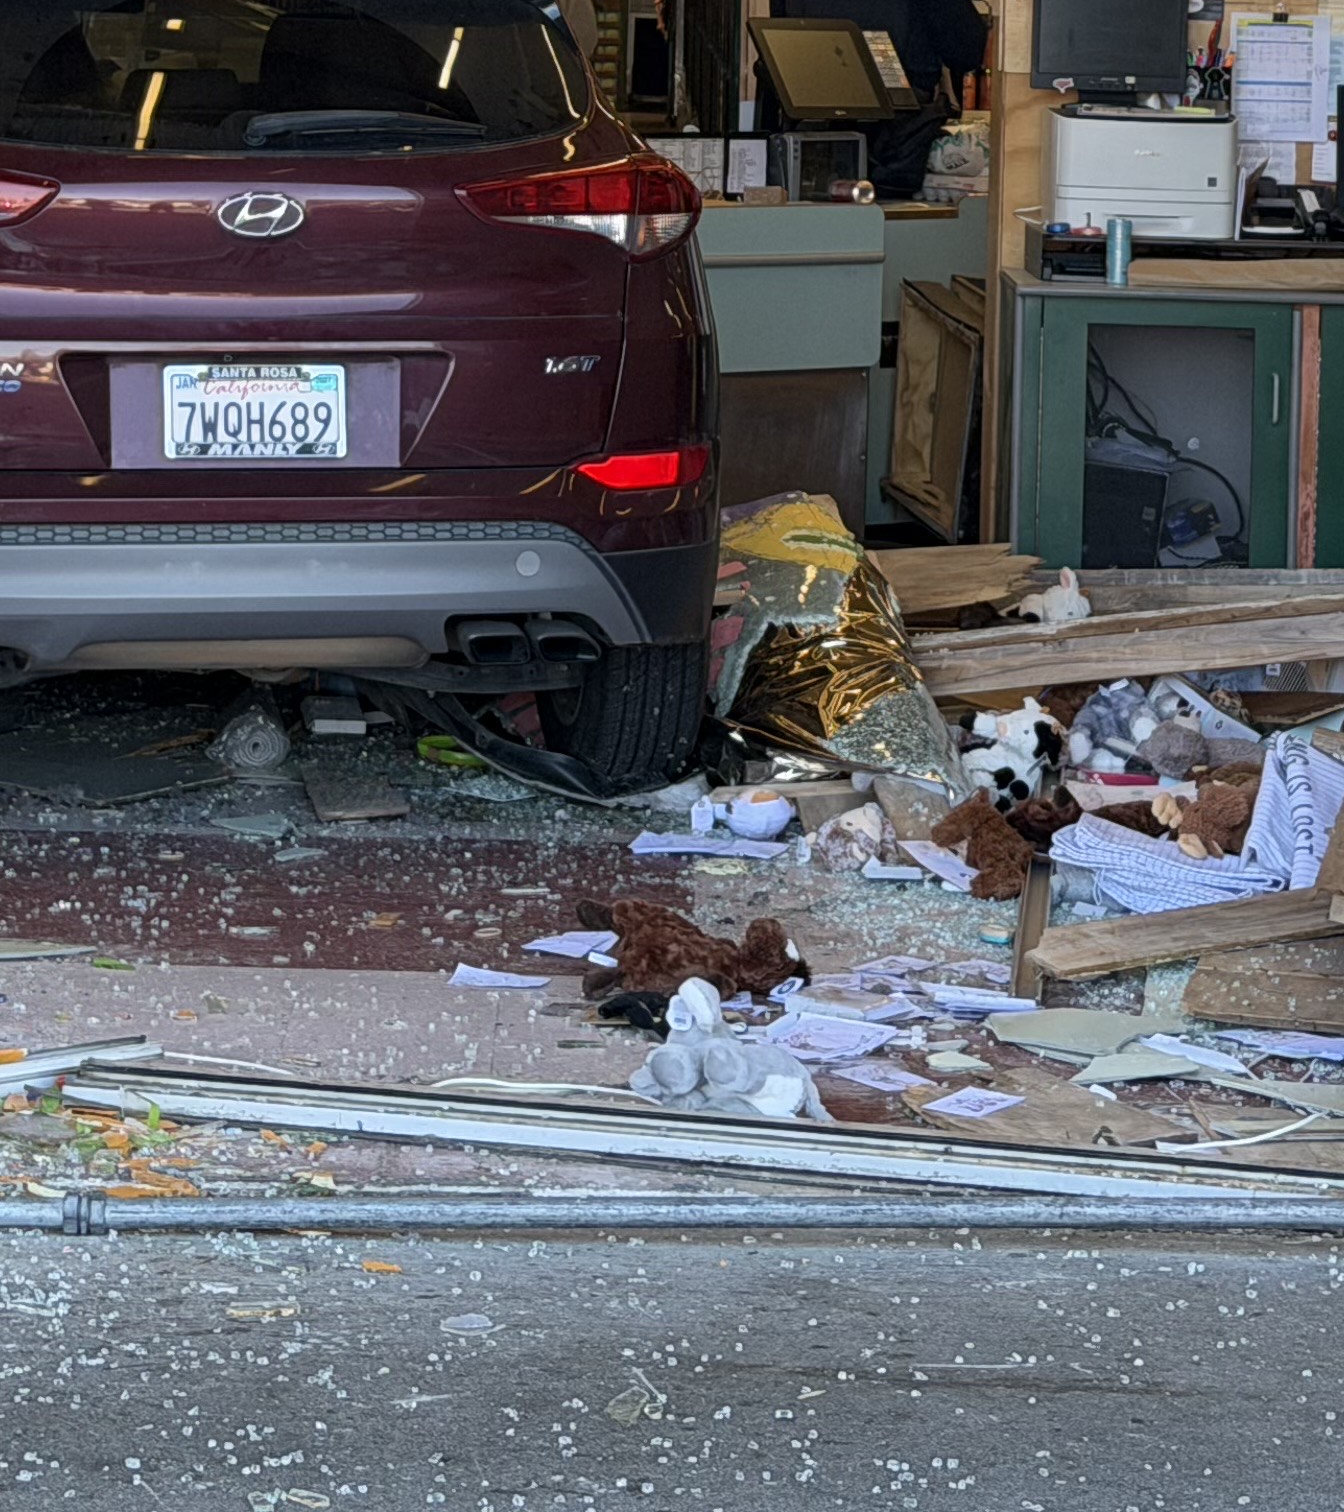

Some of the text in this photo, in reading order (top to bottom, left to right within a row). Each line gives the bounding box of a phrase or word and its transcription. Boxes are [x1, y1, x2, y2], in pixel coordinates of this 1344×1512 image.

[211, 366, 299, 379] SANTA ROSA
[175, 376, 198, 390] JAN
[203, 379, 302, 400] California
[177, 400, 334, 444] 7WQH689
[206, 442, 304, 457] MANLY
